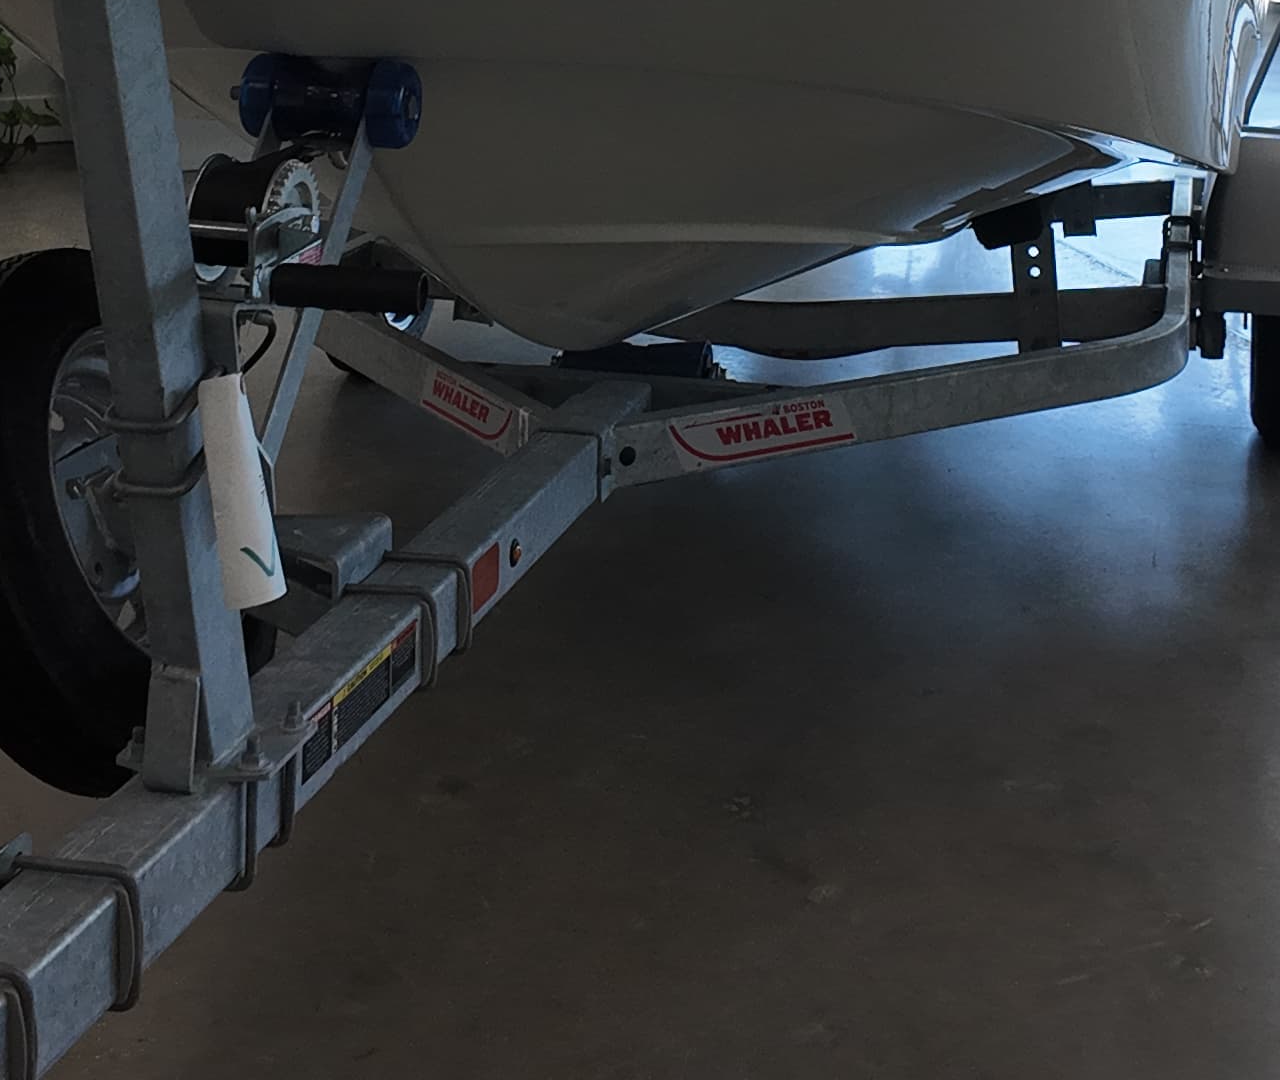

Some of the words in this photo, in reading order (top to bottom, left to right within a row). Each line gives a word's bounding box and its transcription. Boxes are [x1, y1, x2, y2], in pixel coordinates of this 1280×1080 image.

[432, 378, 490, 424] WHALER
[783, 400, 825, 414] BOSTON
[716, 410, 834, 445] WHALER
